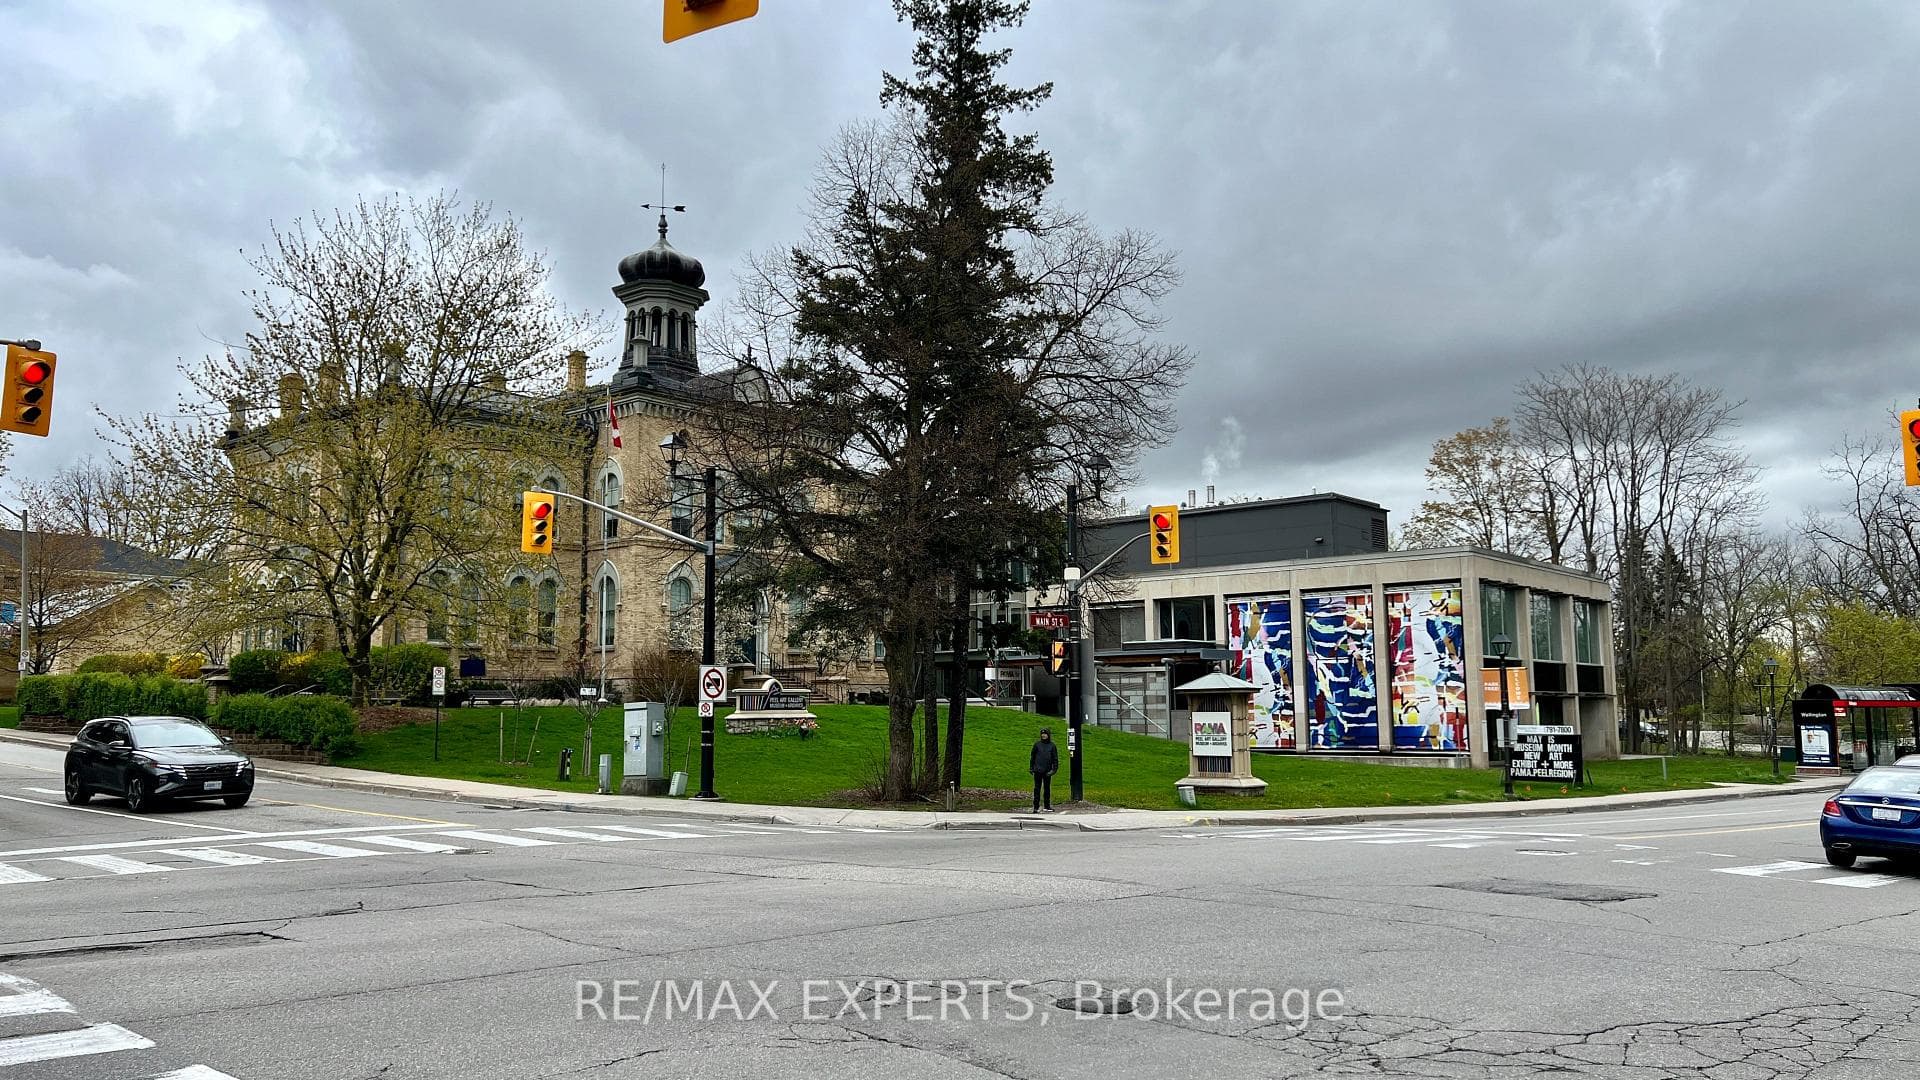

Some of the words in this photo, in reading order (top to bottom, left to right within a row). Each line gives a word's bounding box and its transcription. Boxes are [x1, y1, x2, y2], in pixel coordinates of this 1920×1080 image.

[1035, 617, 1050, 626] MAIN
[1052, 618, 1058, 626] ST
[1194, 723, 1227, 734] PAMA
[1526, 735, 1542, 744] MAY
[1548, 735, 1555, 744] IS
[1514, 743, 1543, 752] MUSEUM
[1547, 744, 1573, 753] MONTH
[1524, 752, 1541, 760] NEW
[1549, 753, 1563, 761] ART
[1512, 760, 1538, 768] EXHIBIT
[1541, 760, 1550, 769] +
[1553, 761, 1574, 770] MORE
